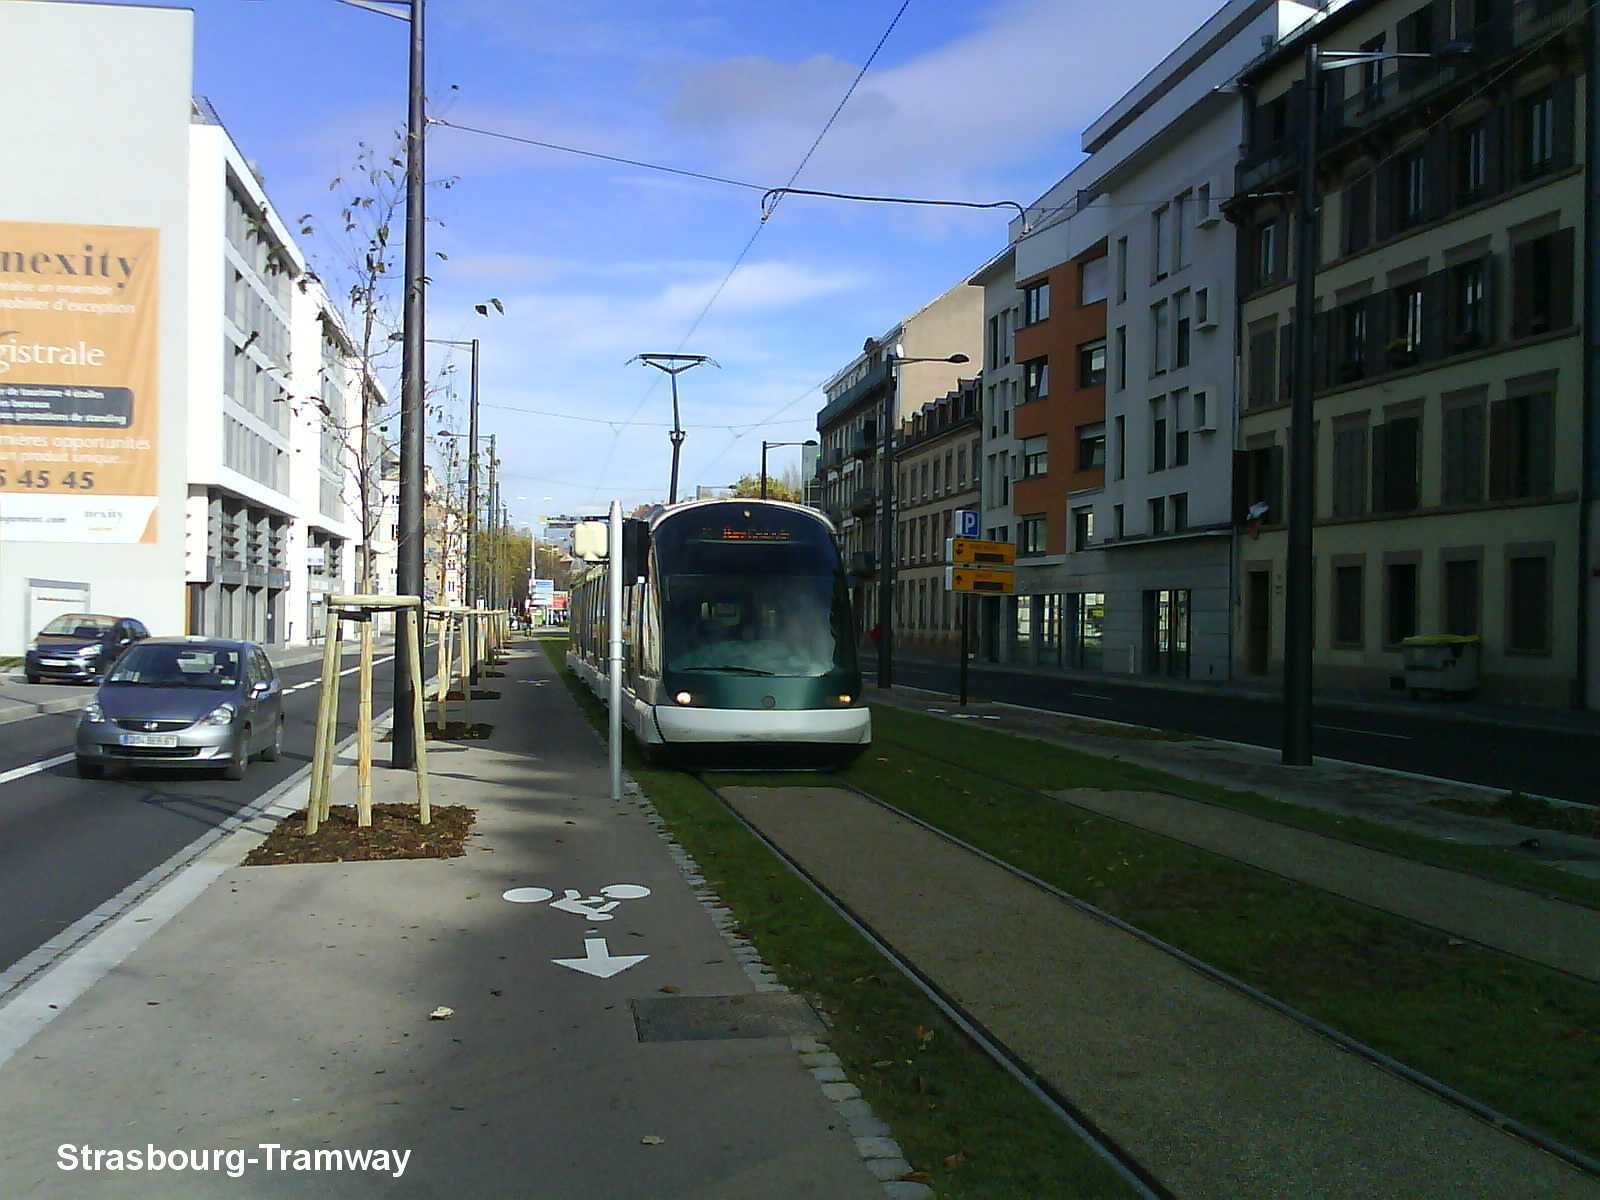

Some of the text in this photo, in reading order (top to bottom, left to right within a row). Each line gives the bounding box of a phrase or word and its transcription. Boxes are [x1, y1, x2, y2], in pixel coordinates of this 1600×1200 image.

[0, 244, 138, 288] nexity
[17, 470, 50, 488] 45
[62, 472, 95, 489] 45
[965, 512, 976, 533] P
